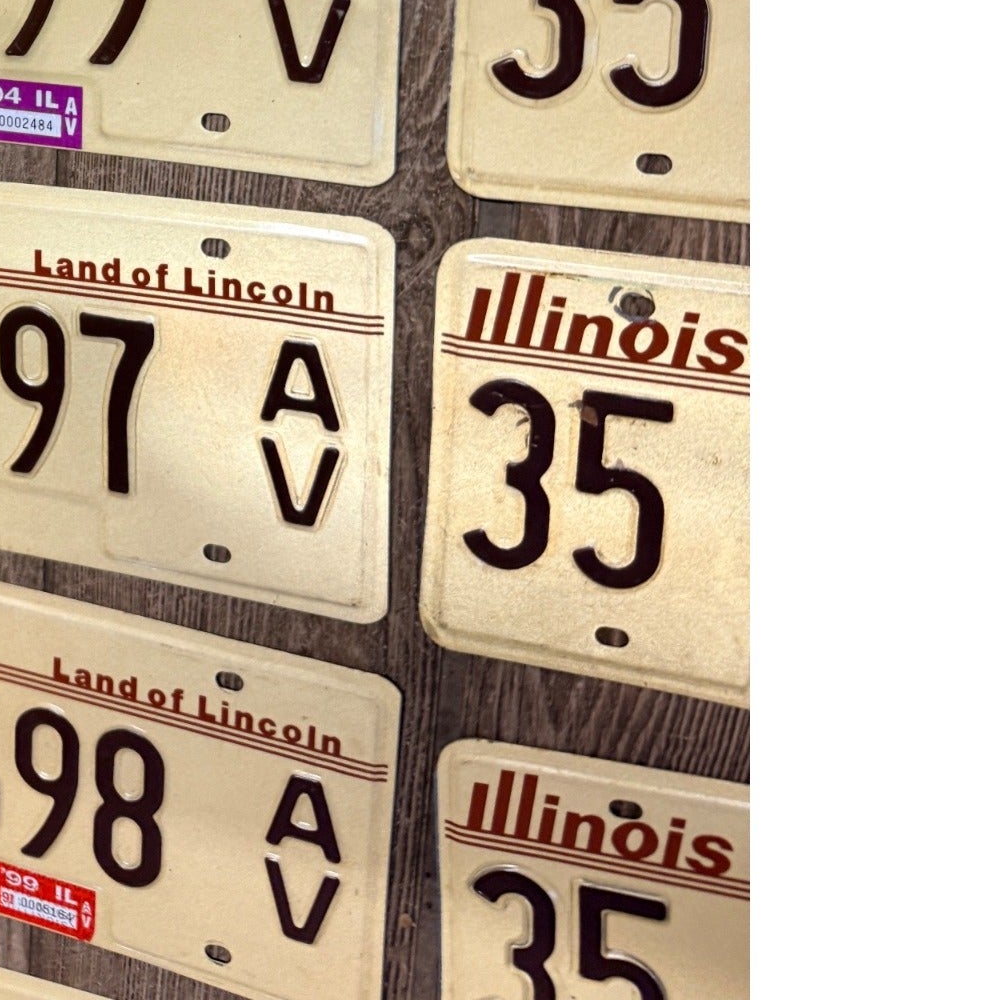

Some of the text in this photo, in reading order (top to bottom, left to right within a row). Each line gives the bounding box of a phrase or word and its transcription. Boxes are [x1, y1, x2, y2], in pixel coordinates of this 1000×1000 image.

[36, 89, 59, 109] IL
[33, 249, 121, 285] Land
[133, 263, 168, 289] of
[184, 267, 335, 313] Lincoln
[465, 272, 748, 373] Illinois
[463, 378, 673, 589] 35
[53, 657, 138, 701] Land
[148, 683, 184, 712] of
[200, 695, 341, 756] Lincoln
[467, 770, 734, 877] Illinois
[55, 885, 77, 906] IL
[473, 870, 666, 1000] 35
